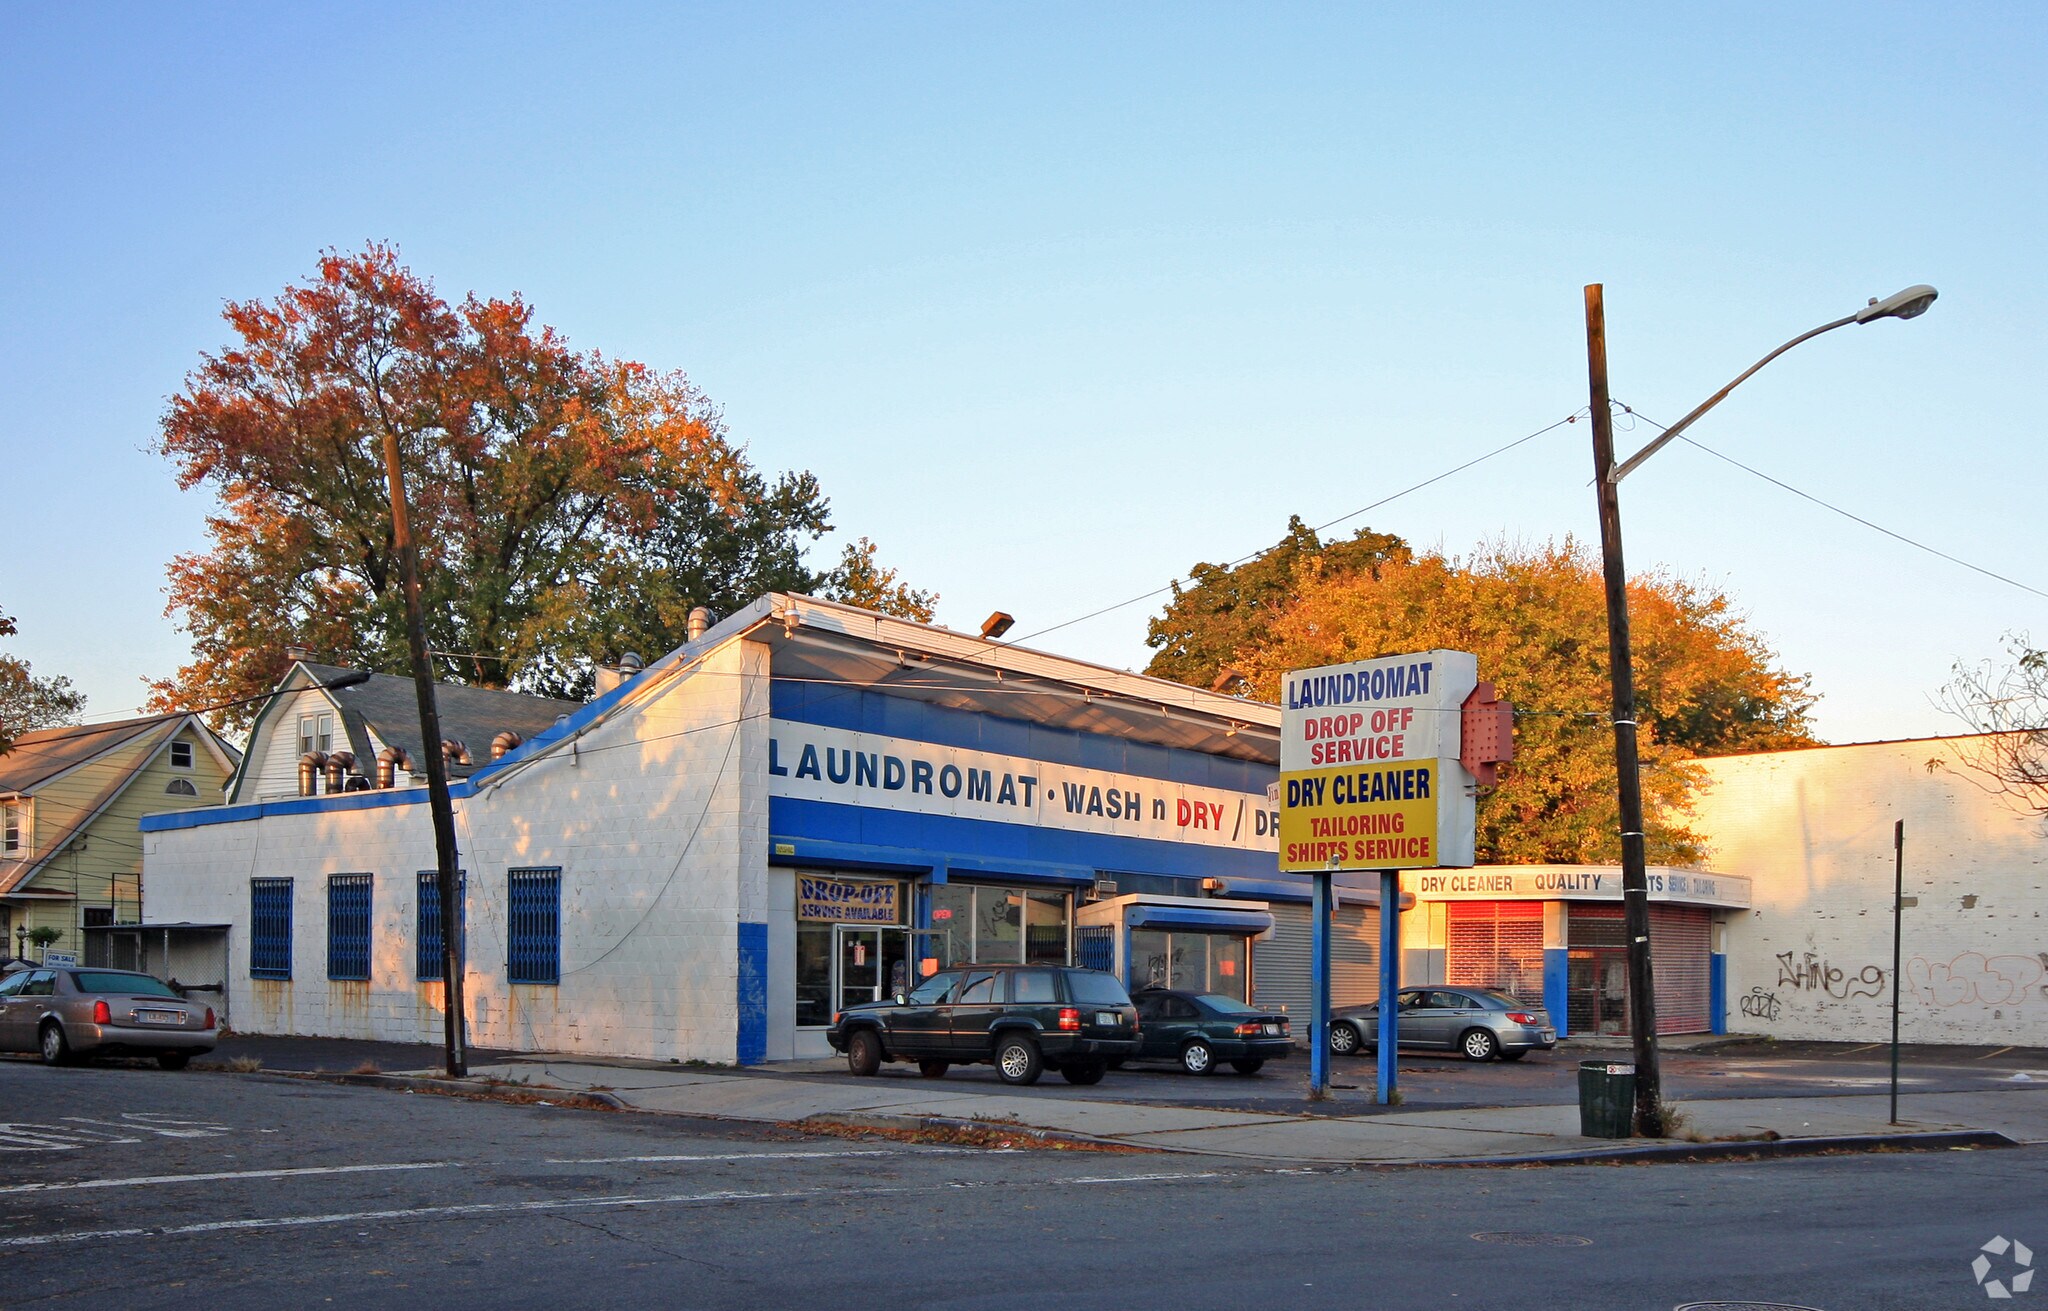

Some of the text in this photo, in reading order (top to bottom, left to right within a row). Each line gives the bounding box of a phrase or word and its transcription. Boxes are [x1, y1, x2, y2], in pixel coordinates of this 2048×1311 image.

[1289, 662, 1433, 710] LAUNDROMAT
[1304, 707, 1414, 741] DROP OFF
[1310, 734, 1404, 765] SERVICE
[769, 738, 1038, 808] LAUNDROMAT
[1061, 781, 1141, 822] WASH
[1152, 798, 1166, 821] n
[1176, 798, 1225, 831] DRY
[1287, 768, 1430, 809] DRY CLEANER
[1310, 812, 1404, 838] TAILORING
[1287, 836, 1430, 863] SHIRTS SERVICE
[800, 878, 896, 905] DROP-OFF
[1421, 876, 1447, 892] DRY
[1450, 875, 1513, 891] CLEANER
[1534, 873, 1602, 891] QUALITY
[802, 903, 843, 919] SERVICE
[48, 954, 76, 963] FOR SALE
